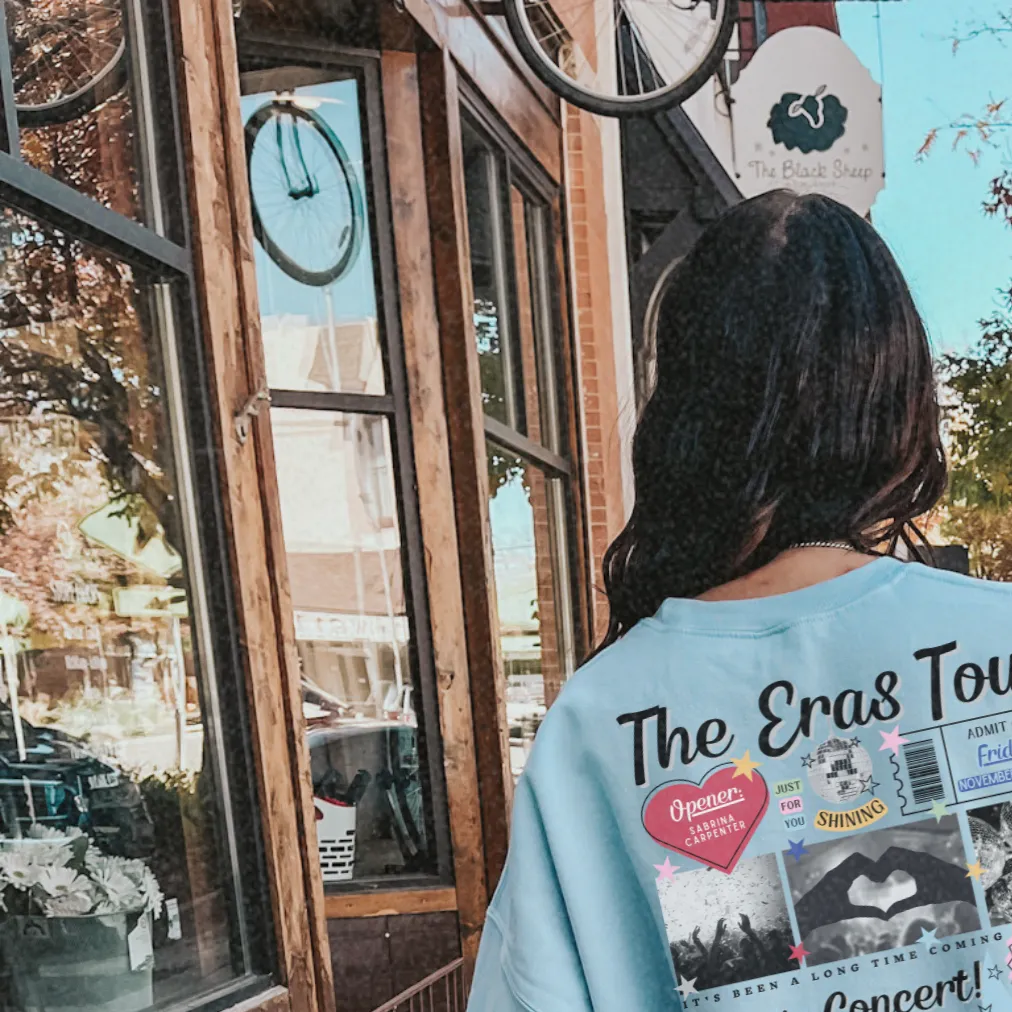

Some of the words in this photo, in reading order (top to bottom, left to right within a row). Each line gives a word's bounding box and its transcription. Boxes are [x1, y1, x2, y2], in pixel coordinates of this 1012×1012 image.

[748, 160, 776, 178] The
[782, 159, 827, 179] Black
[832, 158, 873, 181] Sheep
[616, 705, 735, 786] The
[758, 671, 901, 757] Eras
[967, 720, 1007, 740] ADMIT
[775, 780, 801, 795] JUST
[669, 787, 744, 823] Opener:
[780, 800, 801, 811] FOR
[816, 800, 886, 829] SHINING
[684, 820, 746, 847] CARPENTER
[688, 813, 736, 836] SABRINA
[784, 816, 805, 829] YOU
[683, 993, 721, 1009] IT'S
[732, 981, 778, 999] BEEN
[791, 977, 800, 986] A
[811, 963, 861, 981] LONG
[871, 950, 918, 968] TIME
[929, 932, 1003, 955] COMING
